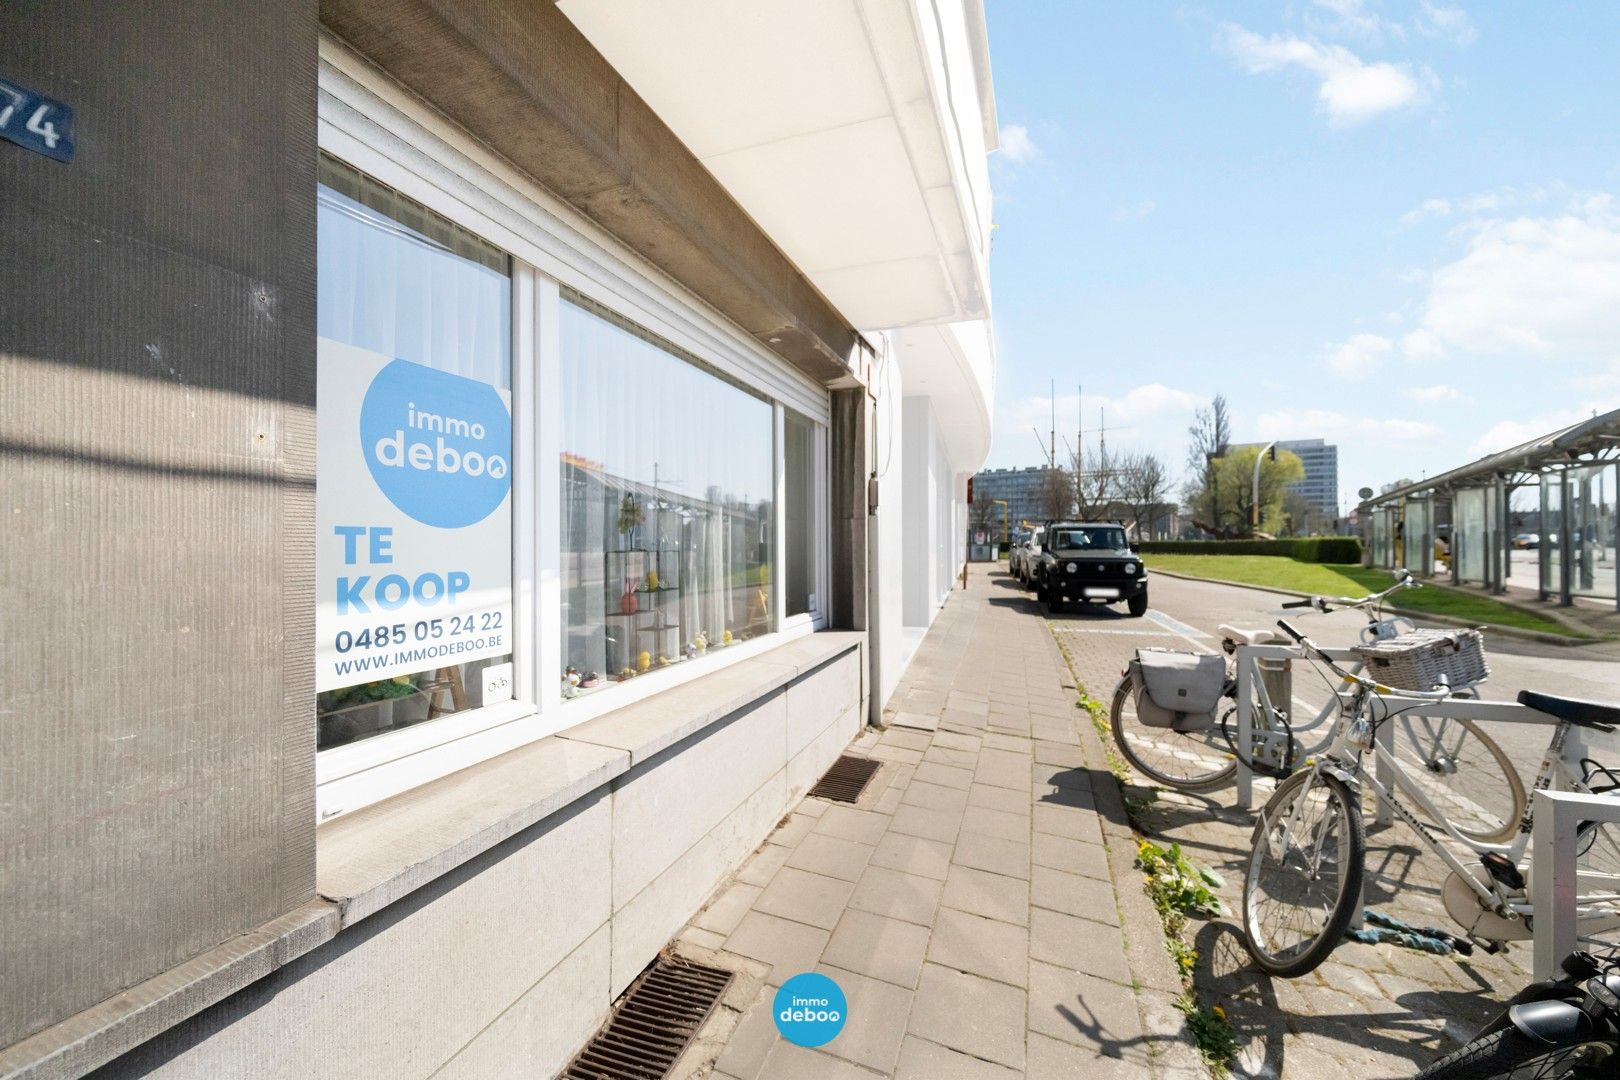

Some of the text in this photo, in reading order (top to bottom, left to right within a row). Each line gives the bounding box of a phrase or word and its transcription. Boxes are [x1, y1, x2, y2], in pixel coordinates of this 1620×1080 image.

[408, 401, 486, 441] immo
[375, 429, 508, 480] deboo
[334, 525, 394, 565] TE
[336, 571, 471, 617] KOOP
[335, 611, 503, 654] 0485 05 24 22
[334, 634, 503, 676] WWW.IMMODEBOO.BE
